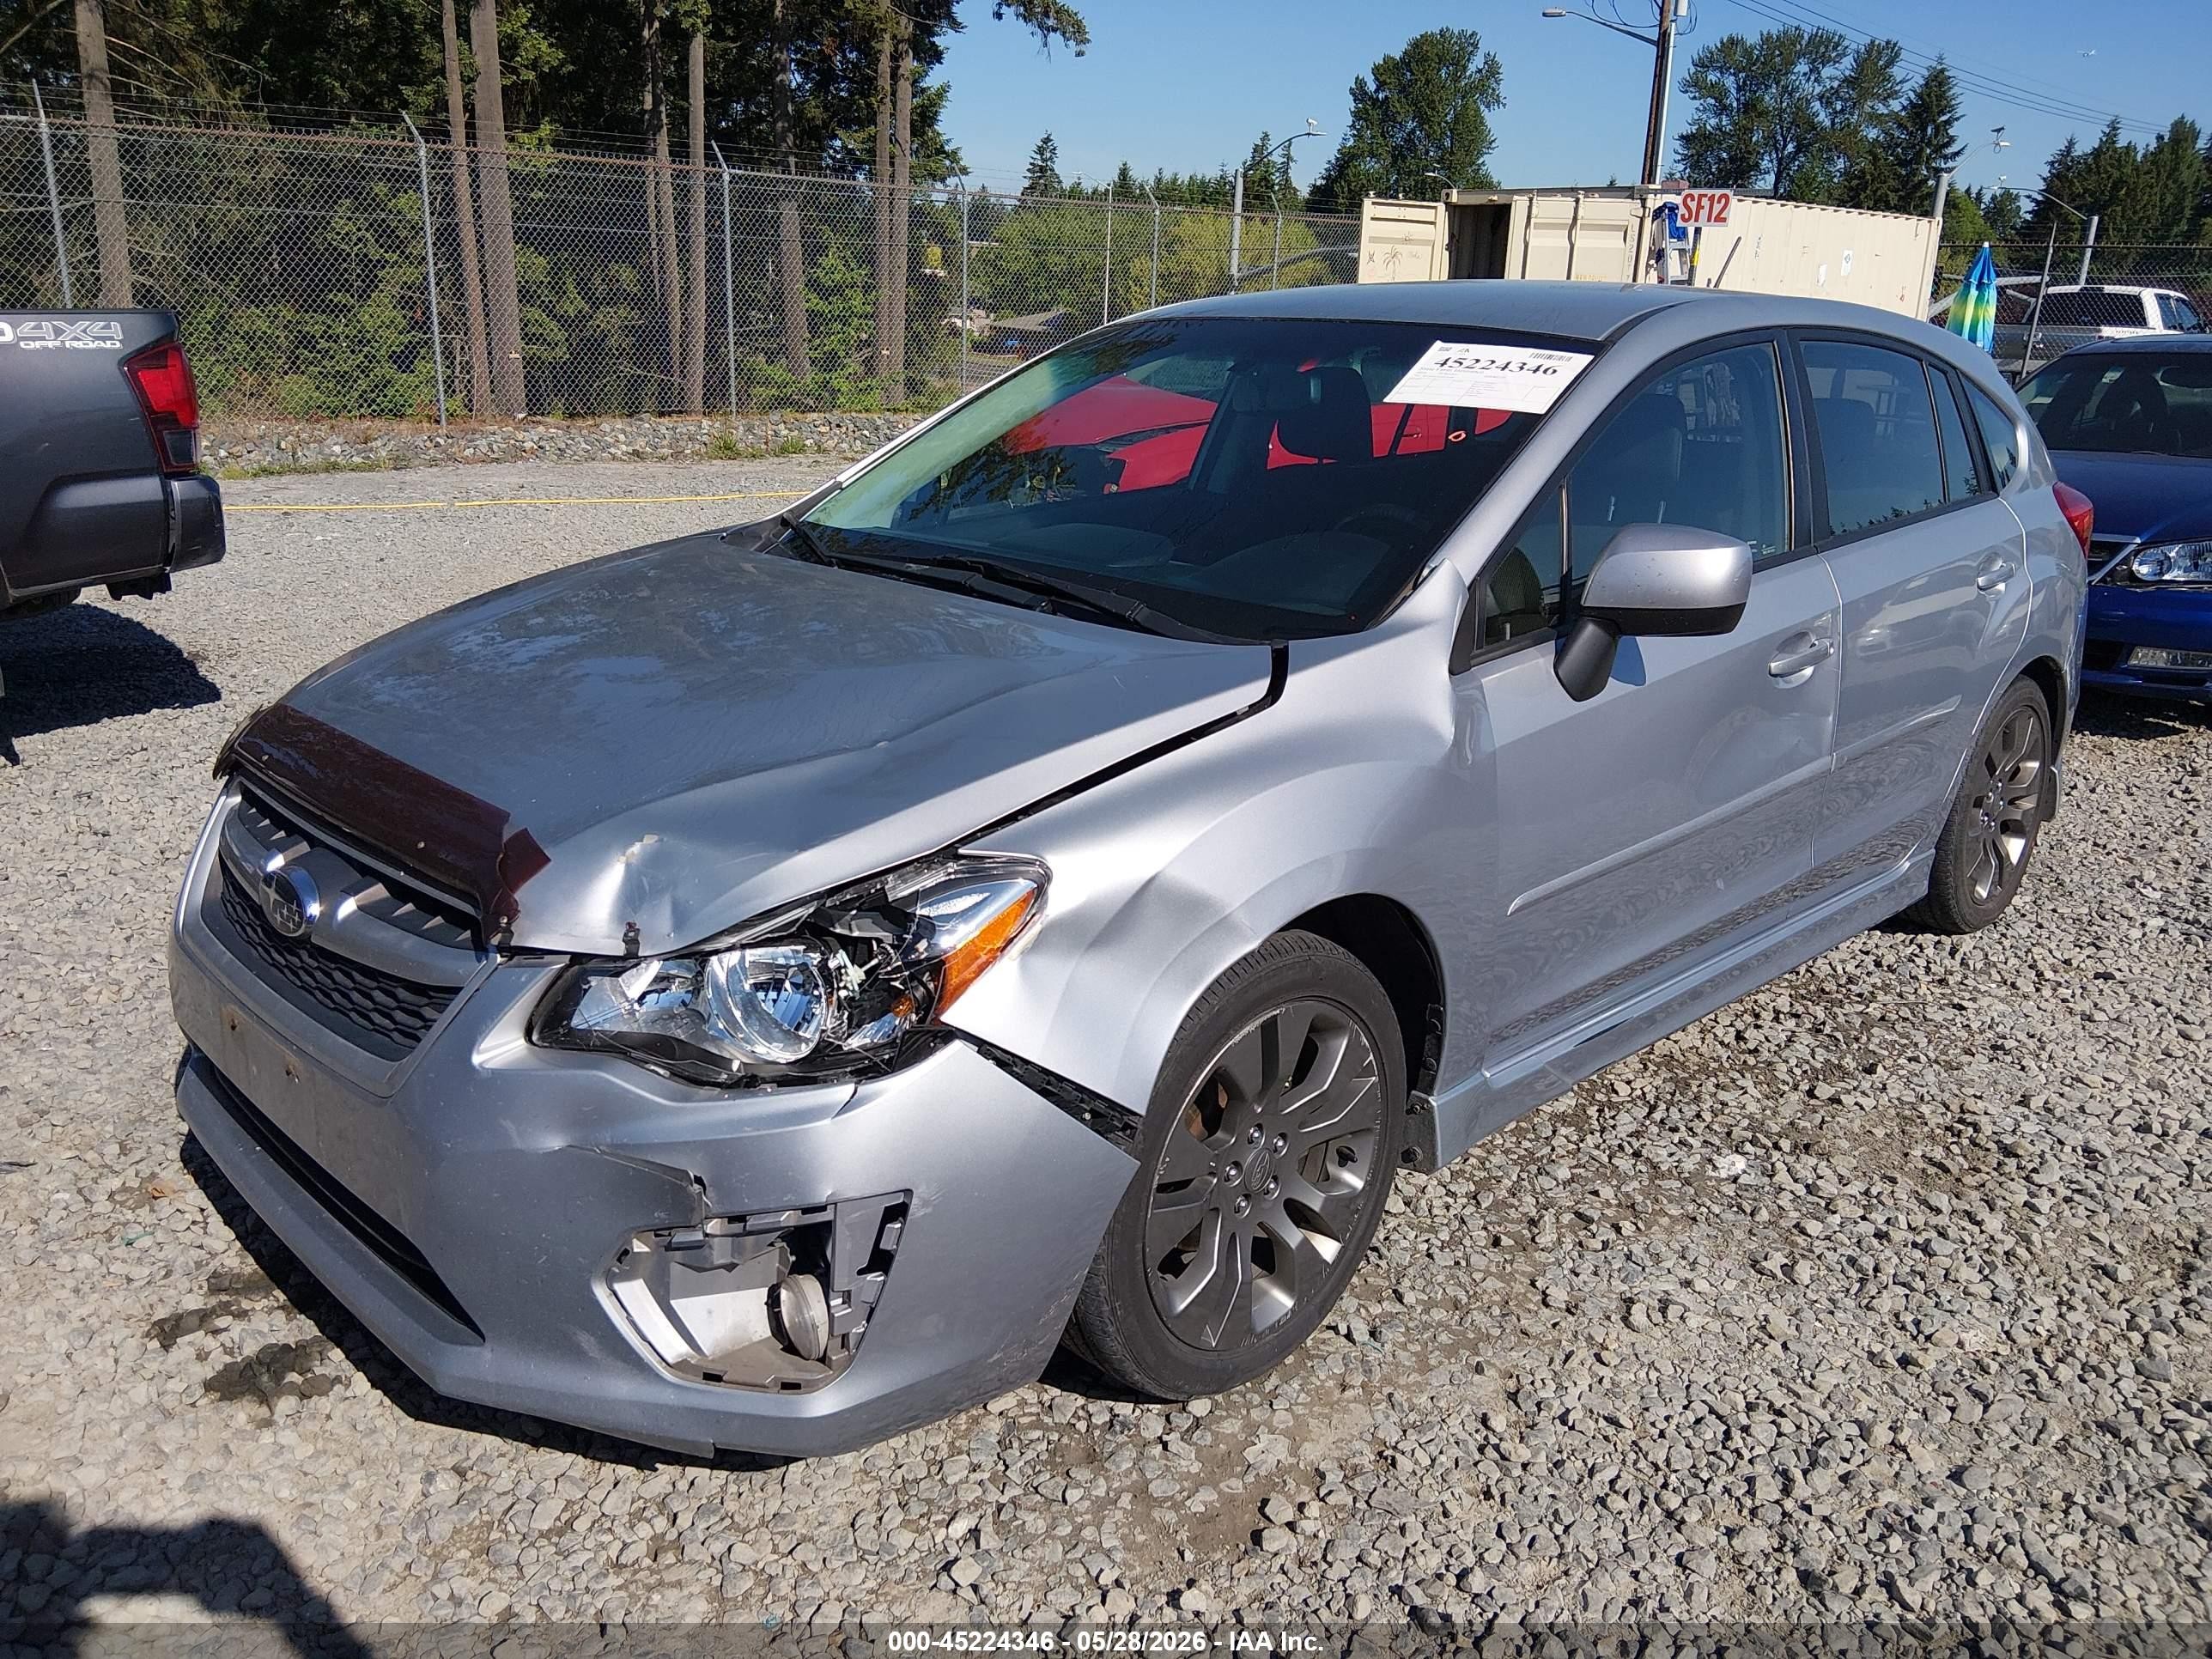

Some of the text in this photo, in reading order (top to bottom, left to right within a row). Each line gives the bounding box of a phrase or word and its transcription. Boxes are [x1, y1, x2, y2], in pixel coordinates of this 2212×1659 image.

[1680, 192, 1731, 223] SF12
[20, 340, 123, 349] OFF ROAD
[1434, 356, 1559, 376] 45224346
